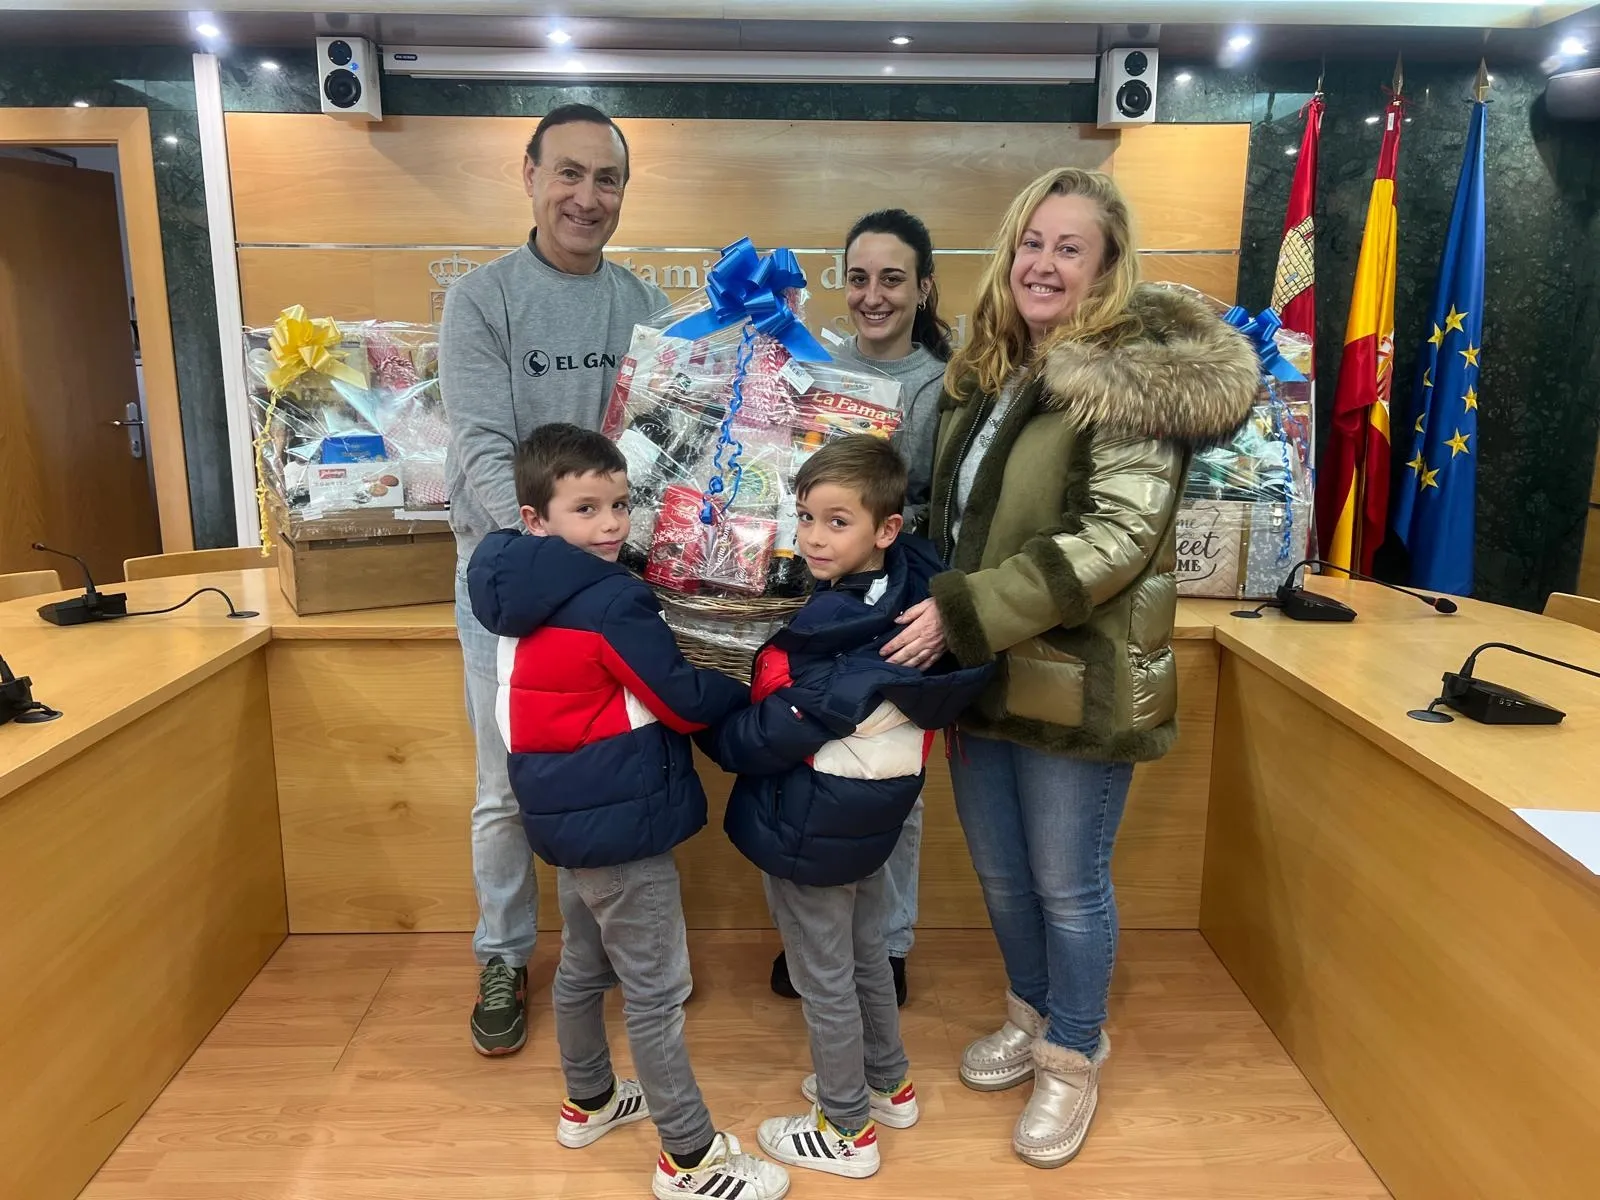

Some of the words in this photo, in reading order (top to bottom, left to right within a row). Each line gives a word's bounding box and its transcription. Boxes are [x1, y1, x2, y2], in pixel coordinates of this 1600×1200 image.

[555, 355, 579, 371] EL
[583, 352, 616, 369] GAN
[812, 390, 834, 407] La
[837, 397, 888, 422] Fama
[1176, 531, 1221, 560] eet
[1176, 559, 1202, 572] ME
